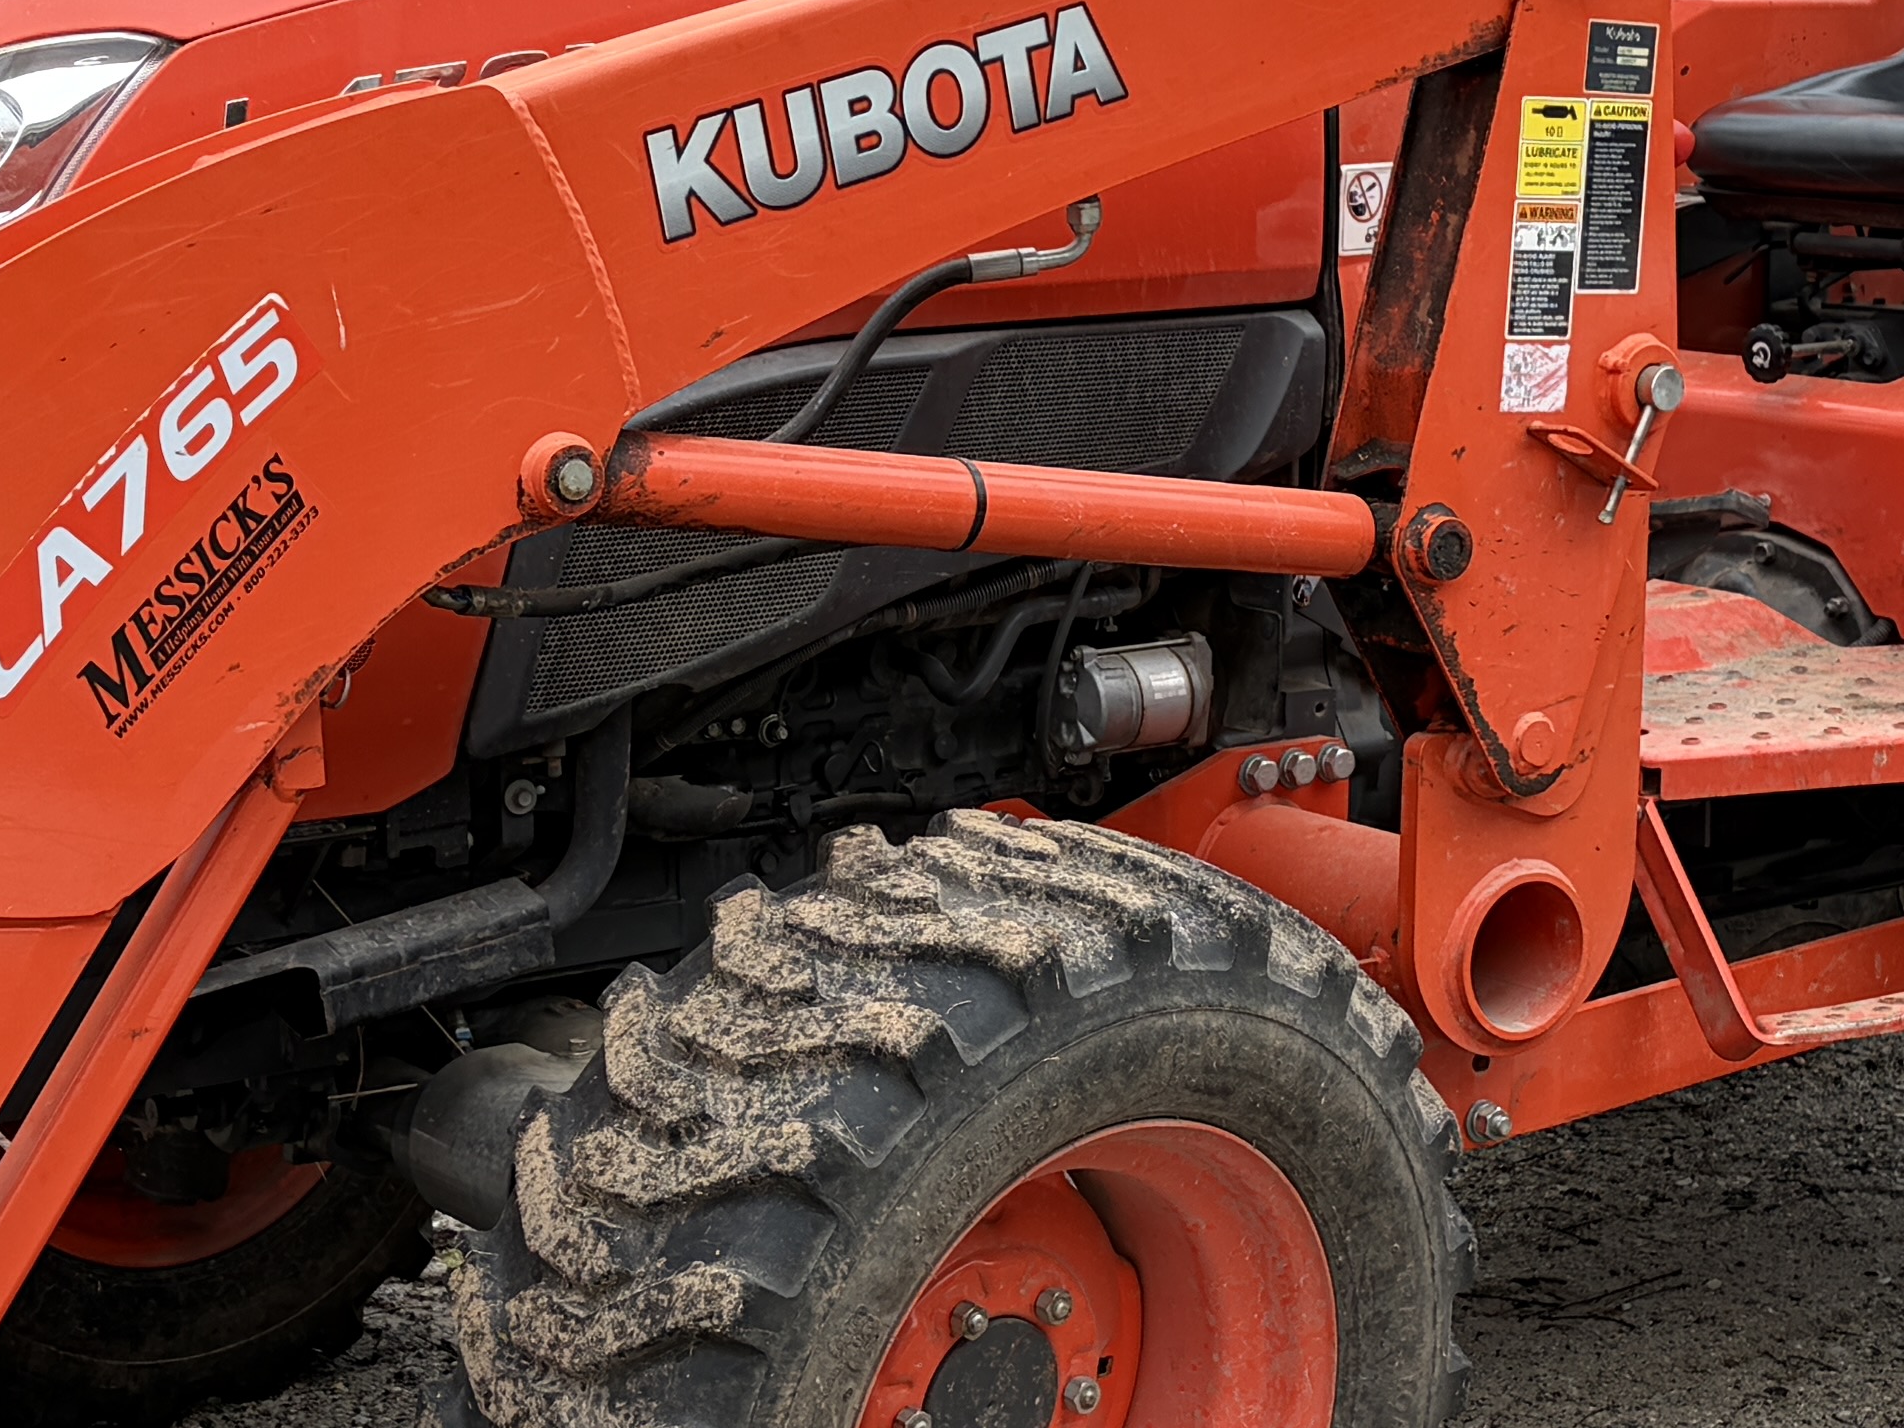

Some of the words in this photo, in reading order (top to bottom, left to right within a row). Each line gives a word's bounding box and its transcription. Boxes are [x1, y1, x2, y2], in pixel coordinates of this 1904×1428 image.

[1605, 26, 1642, 42] Kubota
[643, 1, 1128, 245] KUBOTA
[1603, 105, 1648, 118] CAUTION
[1525, 146, 1578, 159] LUBRICATE
[1529, 206, 1575, 221] WARNING
[243, 505, 321, 594] 800-222-3373
[76, 453, 295, 730] MESSICK'S
[164, 608, 205, 658] Helping
[202, 577, 231, 613] Hand
[228, 551, 254, 583] With
[250, 526, 275, 556] Your
[273, 498, 300, 531] Land
